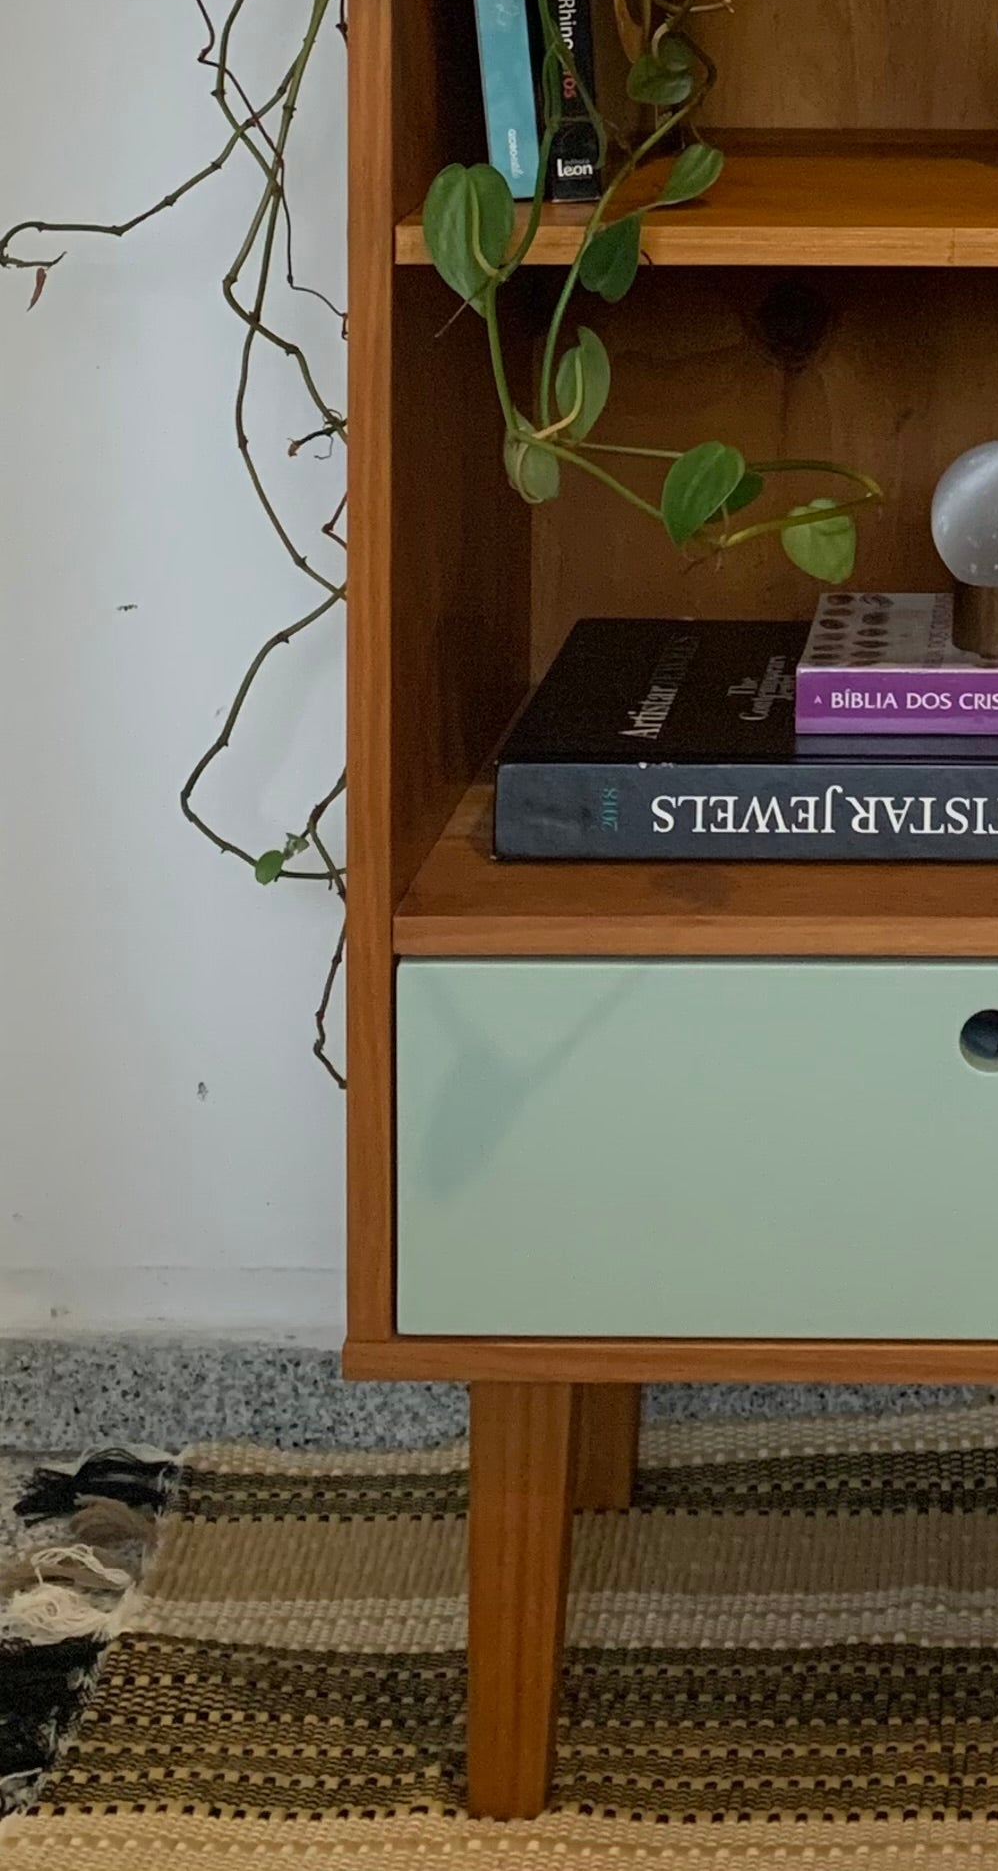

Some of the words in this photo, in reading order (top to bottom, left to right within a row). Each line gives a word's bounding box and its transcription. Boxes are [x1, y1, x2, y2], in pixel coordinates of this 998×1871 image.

[556, 158, 593, 178] leon
[617, 685, 678, 740] Artistar
[813, 695, 823, 705] A
[830, 688, 899, 710] BÍBLIA
[906, 692, 952, 710] DOS
[650, 785, 844, 834] JEWELS
